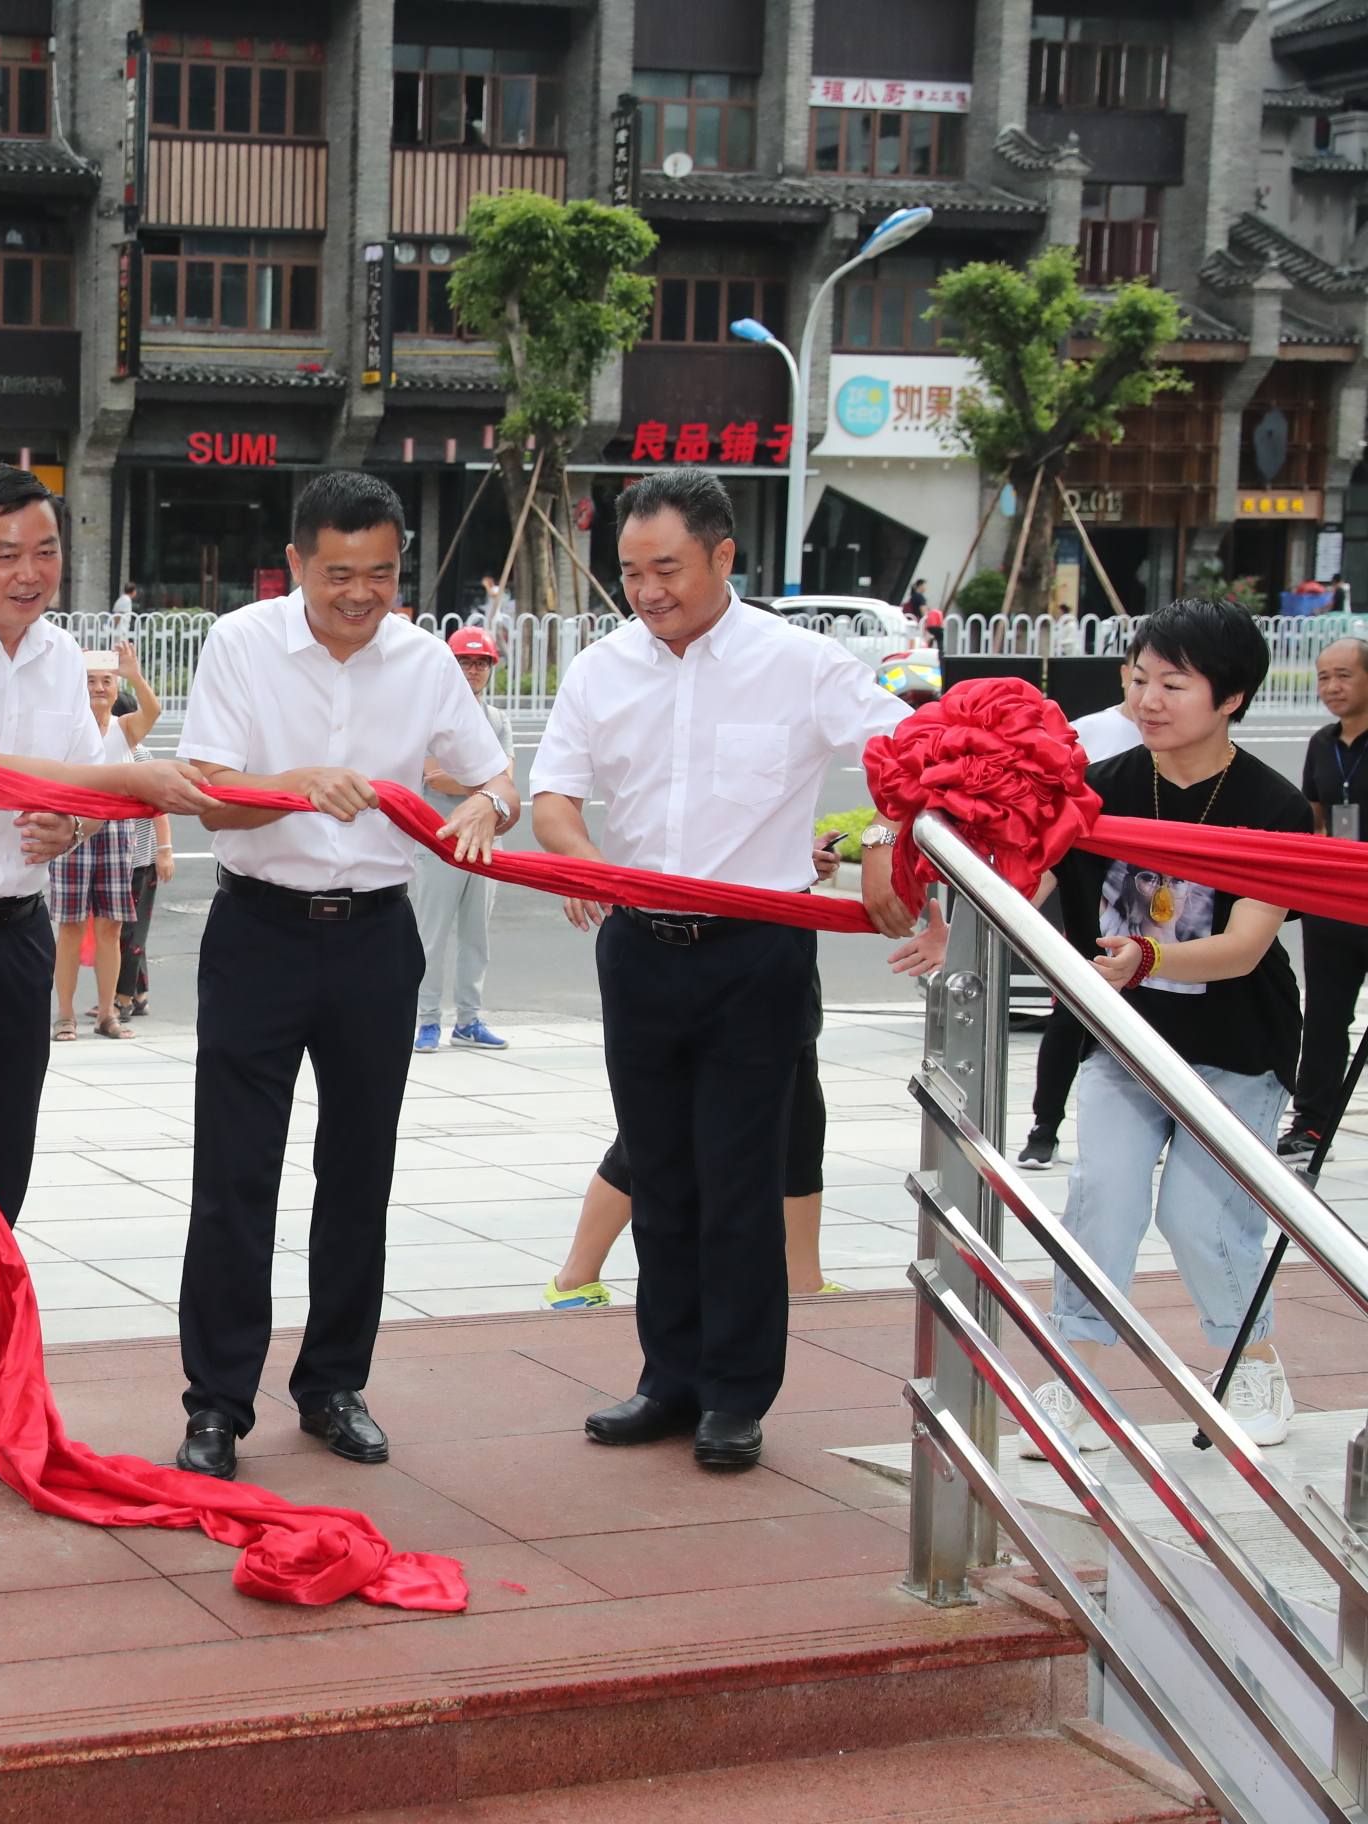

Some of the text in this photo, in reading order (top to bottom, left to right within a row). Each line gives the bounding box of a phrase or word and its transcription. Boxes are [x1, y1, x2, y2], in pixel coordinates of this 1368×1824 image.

[811, 79, 906, 106] 福小厨
[188, 431, 277, 466] SUM!
[631, 419, 794, 463] 良品铺子
